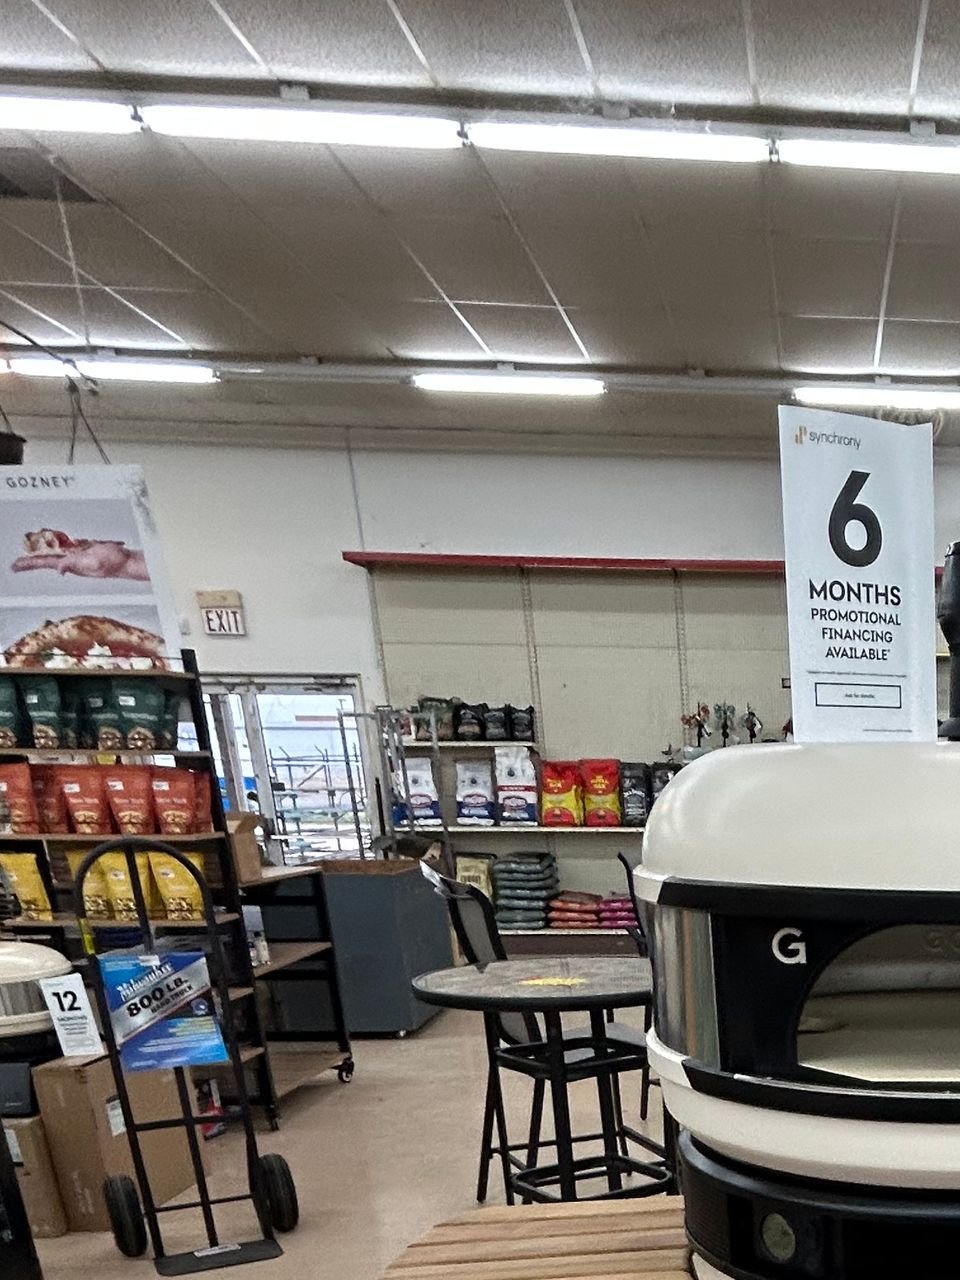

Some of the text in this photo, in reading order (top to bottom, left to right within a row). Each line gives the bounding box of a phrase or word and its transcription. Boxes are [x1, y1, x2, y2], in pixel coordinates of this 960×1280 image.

[809, 430, 861, 450] synchrony
[828, 470, 882, 567] 6
[809, 578, 901, 606] MONTHS
[205, 609, 242, 633] EXIT
[811, 607, 901, 626] PROMOTIONAL
[822, 627, 893, 643] FINANCING
[771, 927, 807, 964] G
[52, 991, 82, 1012] 12
[126, 988, 166, 1017] 800
